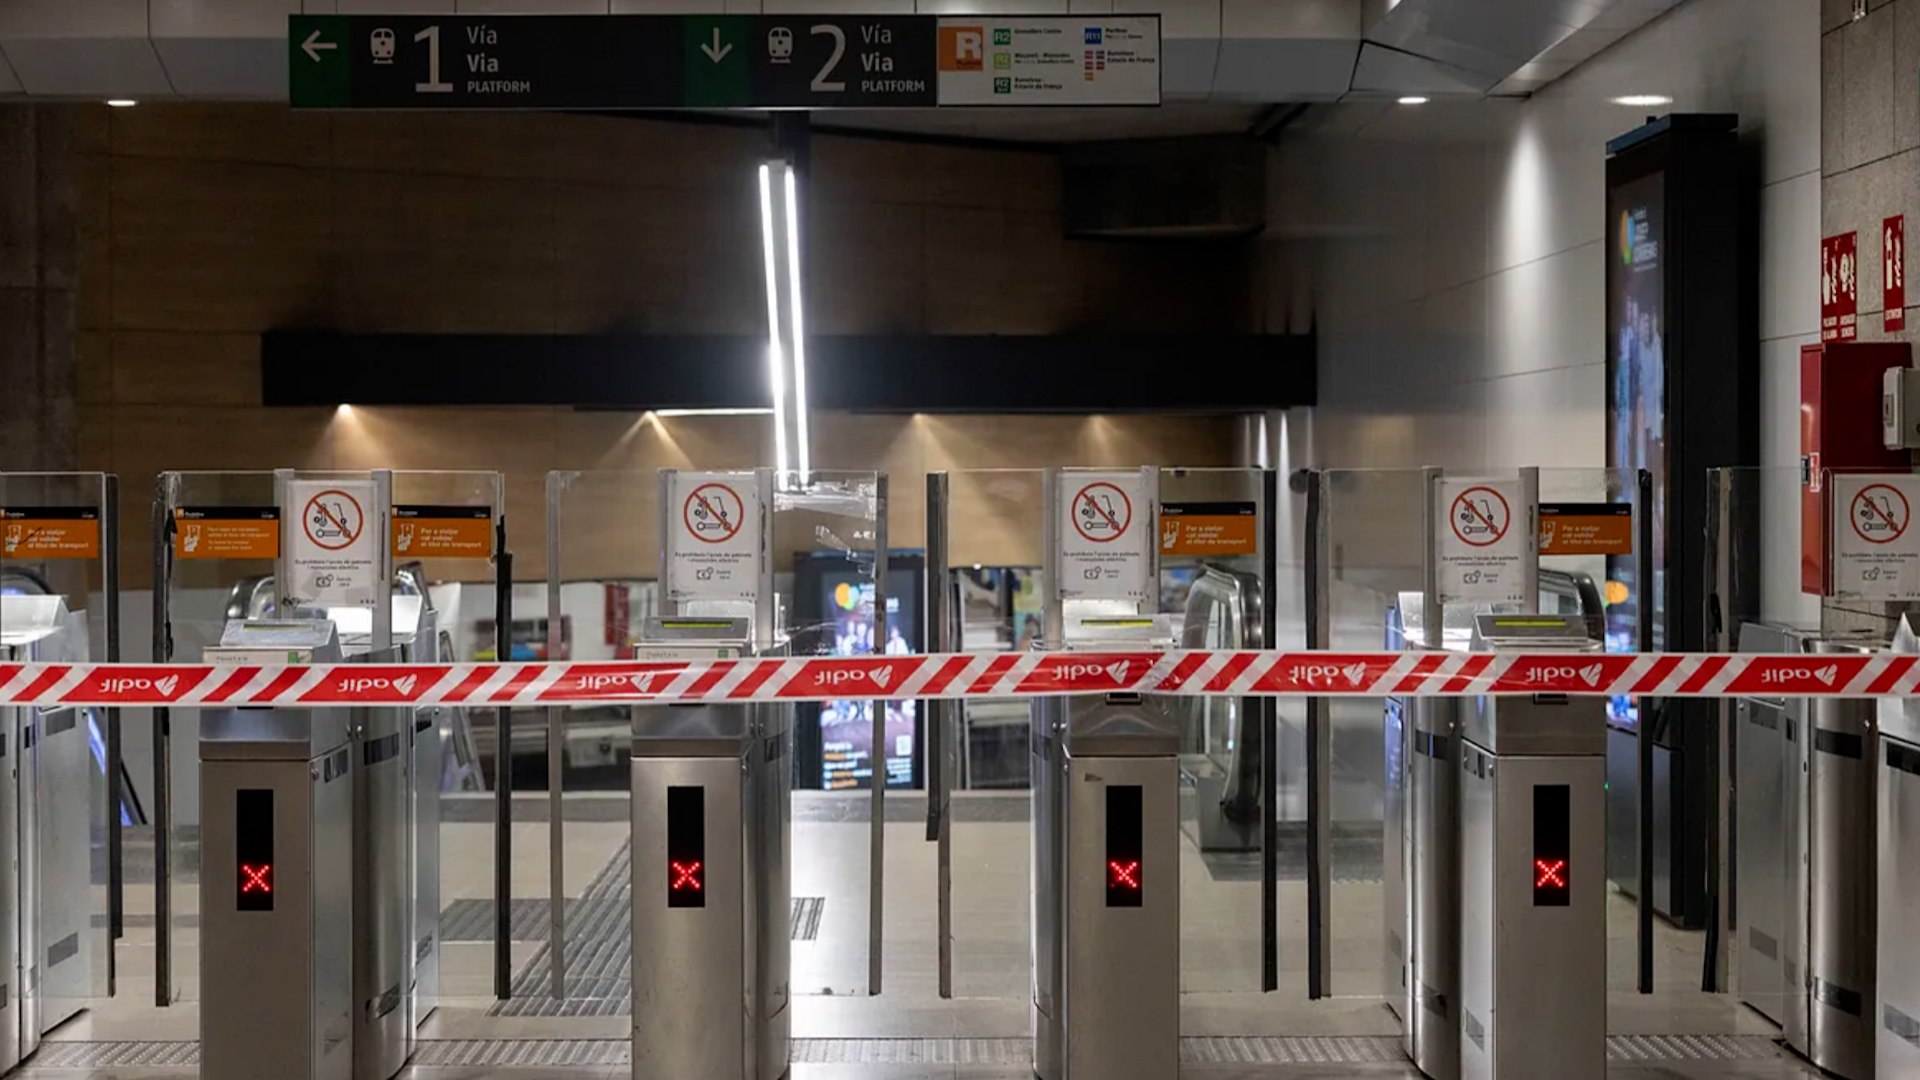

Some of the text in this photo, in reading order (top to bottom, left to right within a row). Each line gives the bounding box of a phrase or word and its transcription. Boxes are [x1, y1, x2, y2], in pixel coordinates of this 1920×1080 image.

[466, 24, 497, 44] Vía
[861, 24, 892, 44] Vía
[994, 31, 1010, 43] R2
[955, 31, 982, 60] R
[413, 25, 453, 93] 1
[467, 52, 499, 73] Via
[809, 24, 847, 92] 2
[861, 52, 894, 73] Via
[467, 80, 530, 93] PLATFORM
[861, 80, 925, 92] PLATFORM
[813, 669, 866, 686] adif
[1050, 663, 1104, 681] adif
[1287, 665, 1340, 685] adif
[1523, 666, 1577, 683] adif
[1760, 667, 1812, 684] adif
[98, 677, 152, 693] adif
[336, 677, 390, 693] adif
[575, 675, 628, 690] adif
